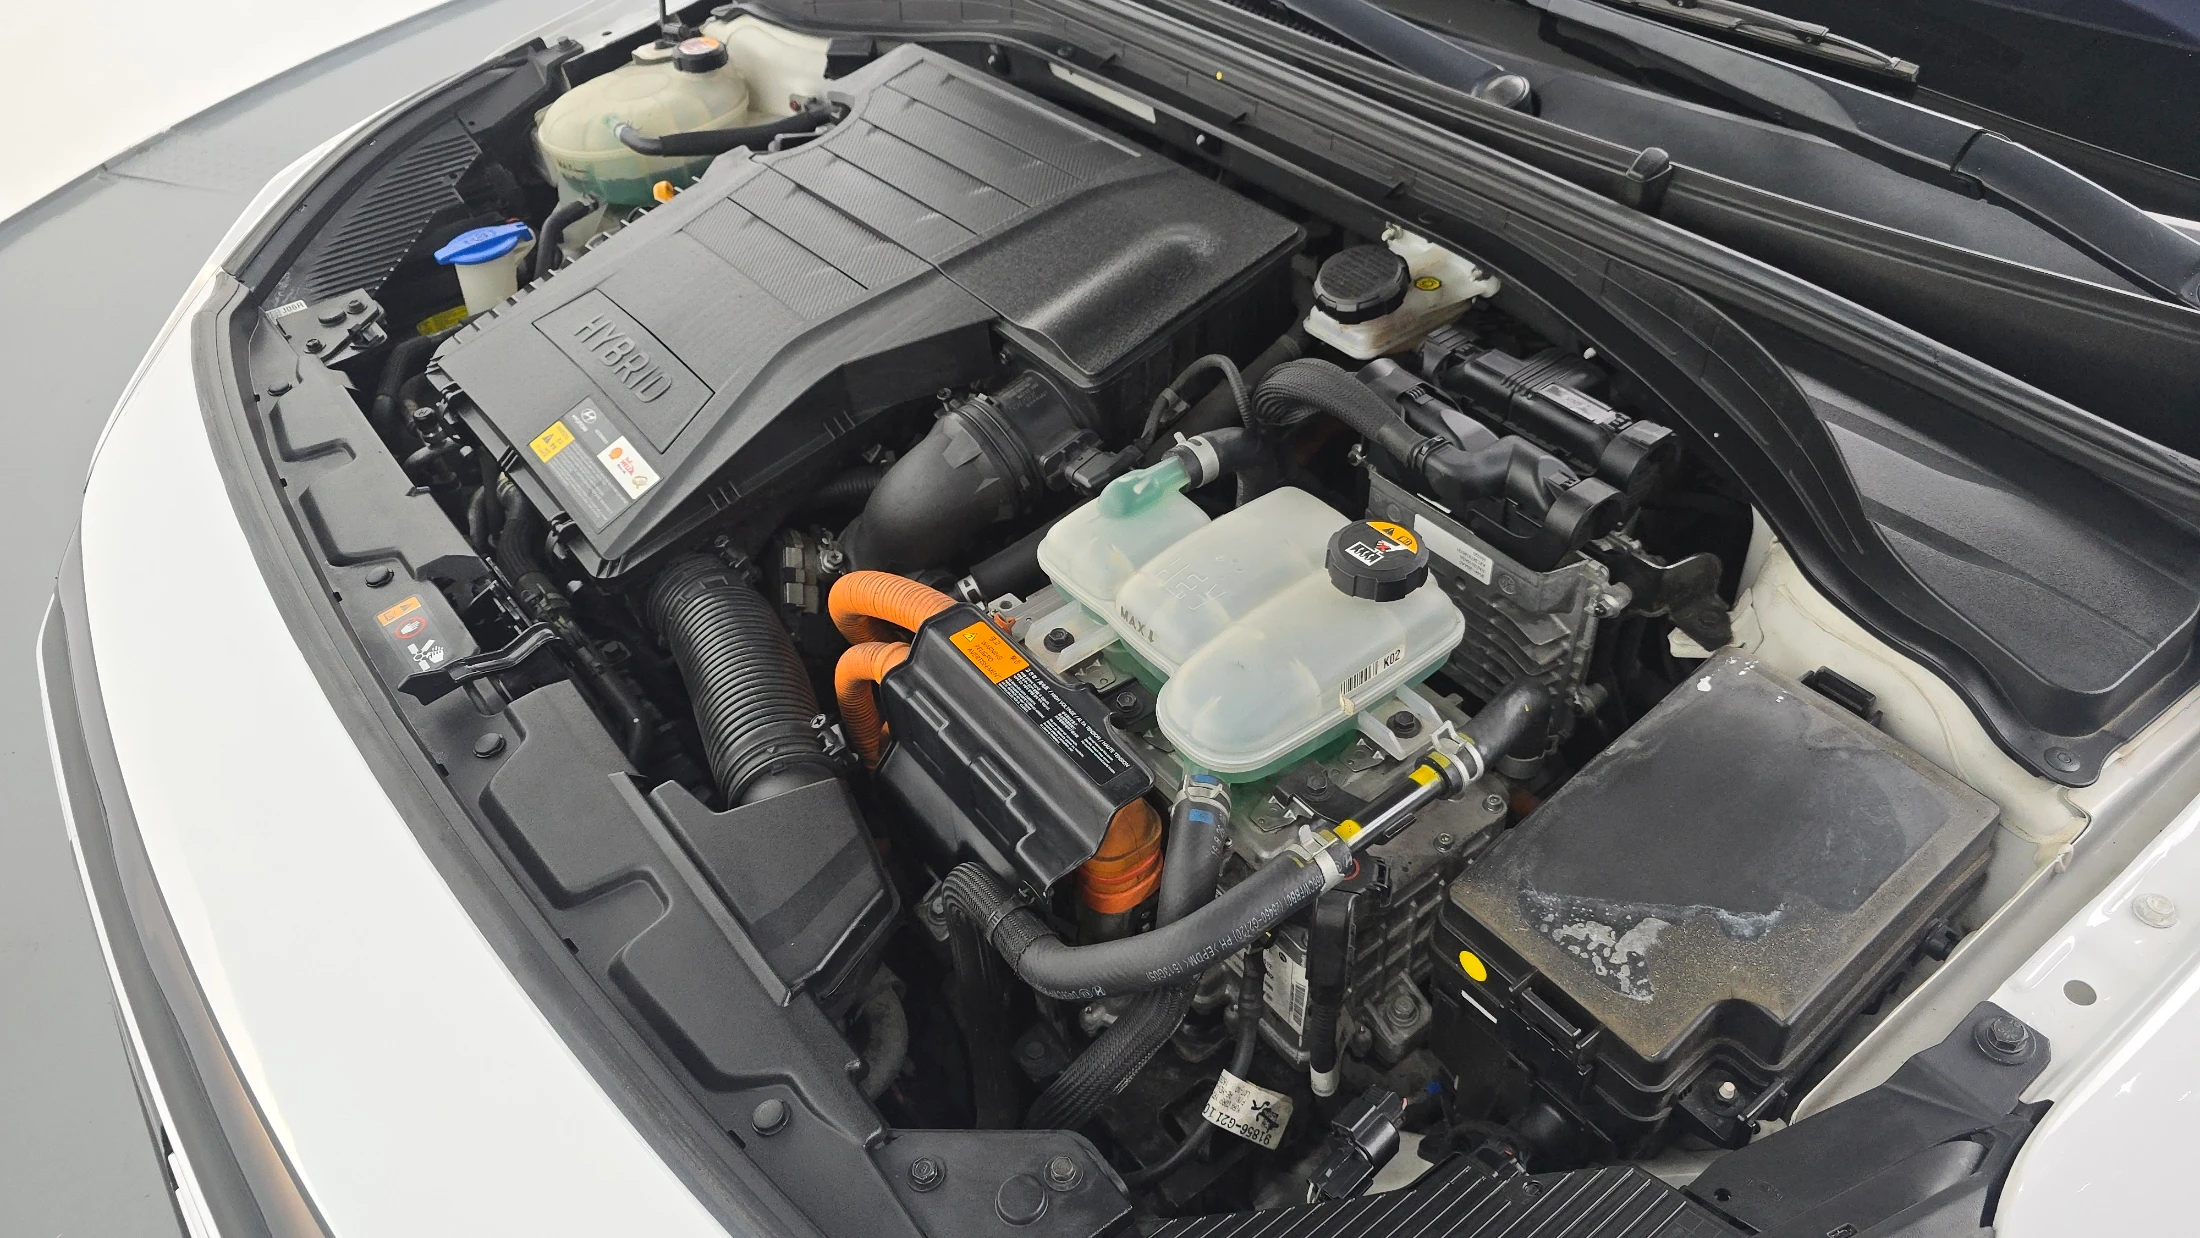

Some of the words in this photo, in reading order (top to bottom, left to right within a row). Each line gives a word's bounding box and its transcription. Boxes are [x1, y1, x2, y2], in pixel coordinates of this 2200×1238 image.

[573, 313, 673, 403] HYBRID
[1120, 605, 1146, 637] MAX
[980, 640, 1004, 662] WARNING
[1383, 649, 1401, 669] K02
[1221, 935, 1233, 947] PH
